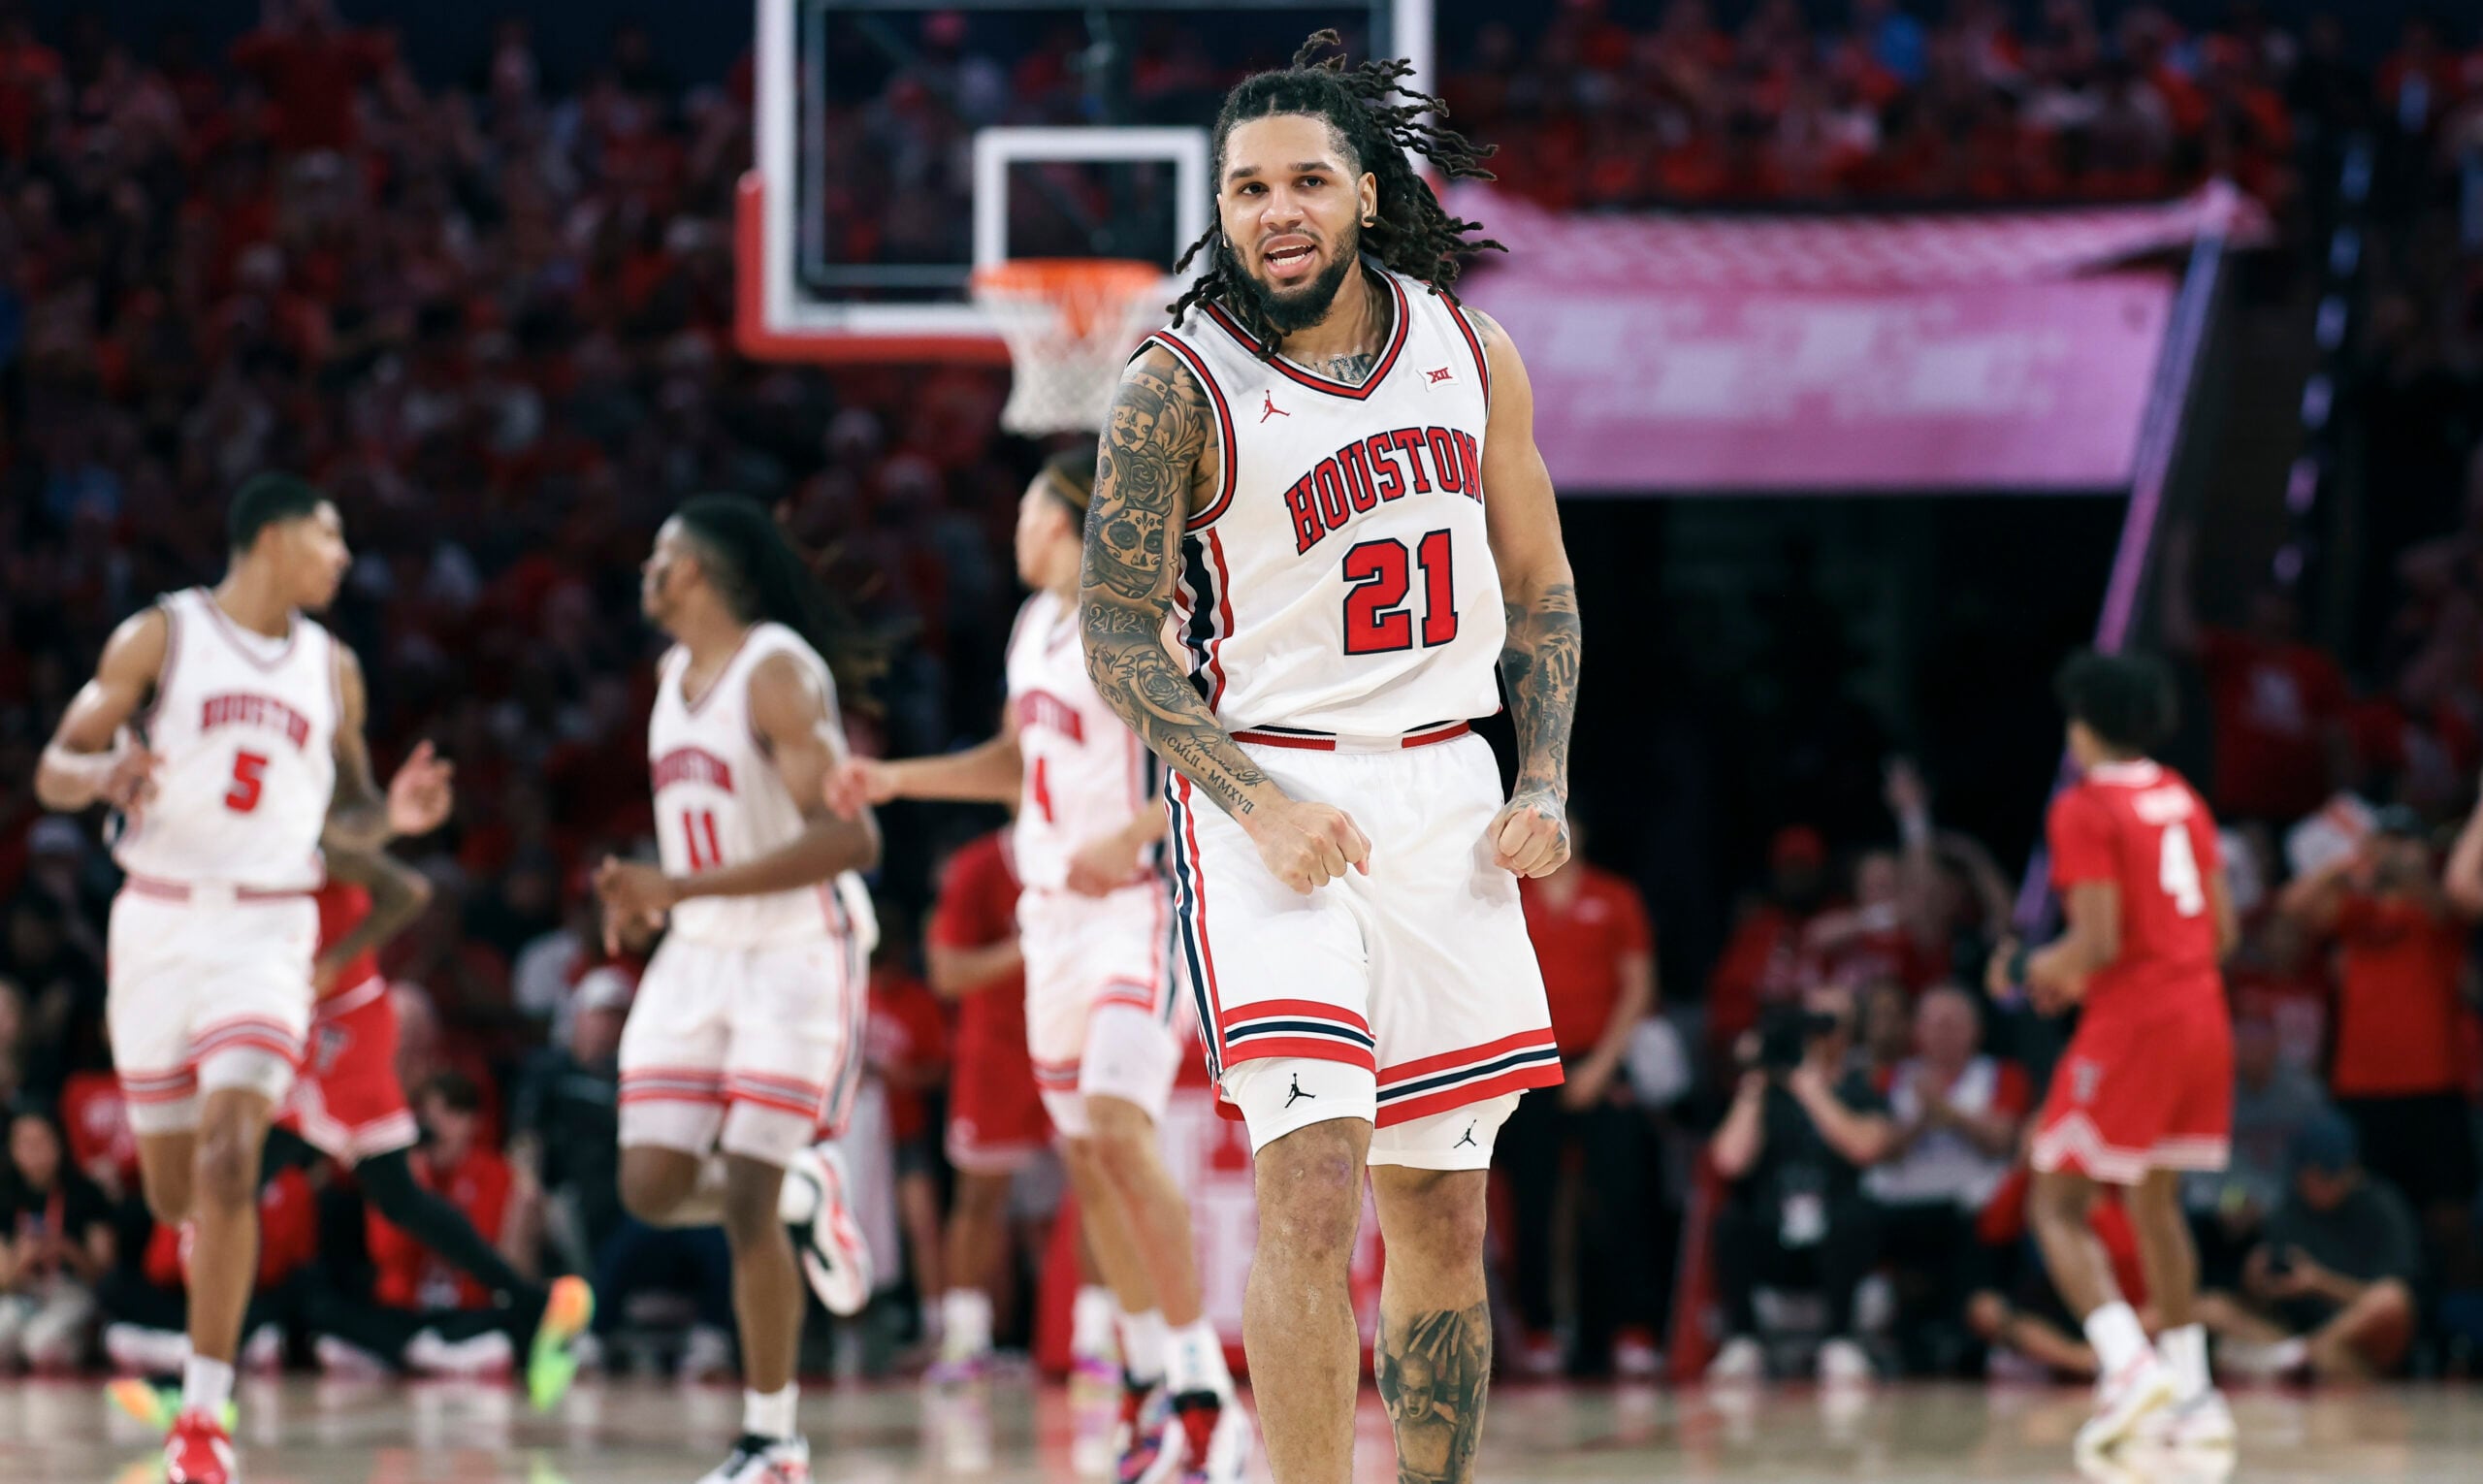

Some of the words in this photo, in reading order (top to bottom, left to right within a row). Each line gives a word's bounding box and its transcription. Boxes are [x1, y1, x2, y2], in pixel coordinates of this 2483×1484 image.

[1426, 367, 1453, 384] XII
[1283, 426, 1483, 557] HOUSTON
[1342, 528, 1459, 657] 21
[224, 750, 269, 813] 5
[1209, 769, 1254, 815] MMXVII
[682, 807, 724, 871] 11
[2159, 820, 2206, 918] 4
